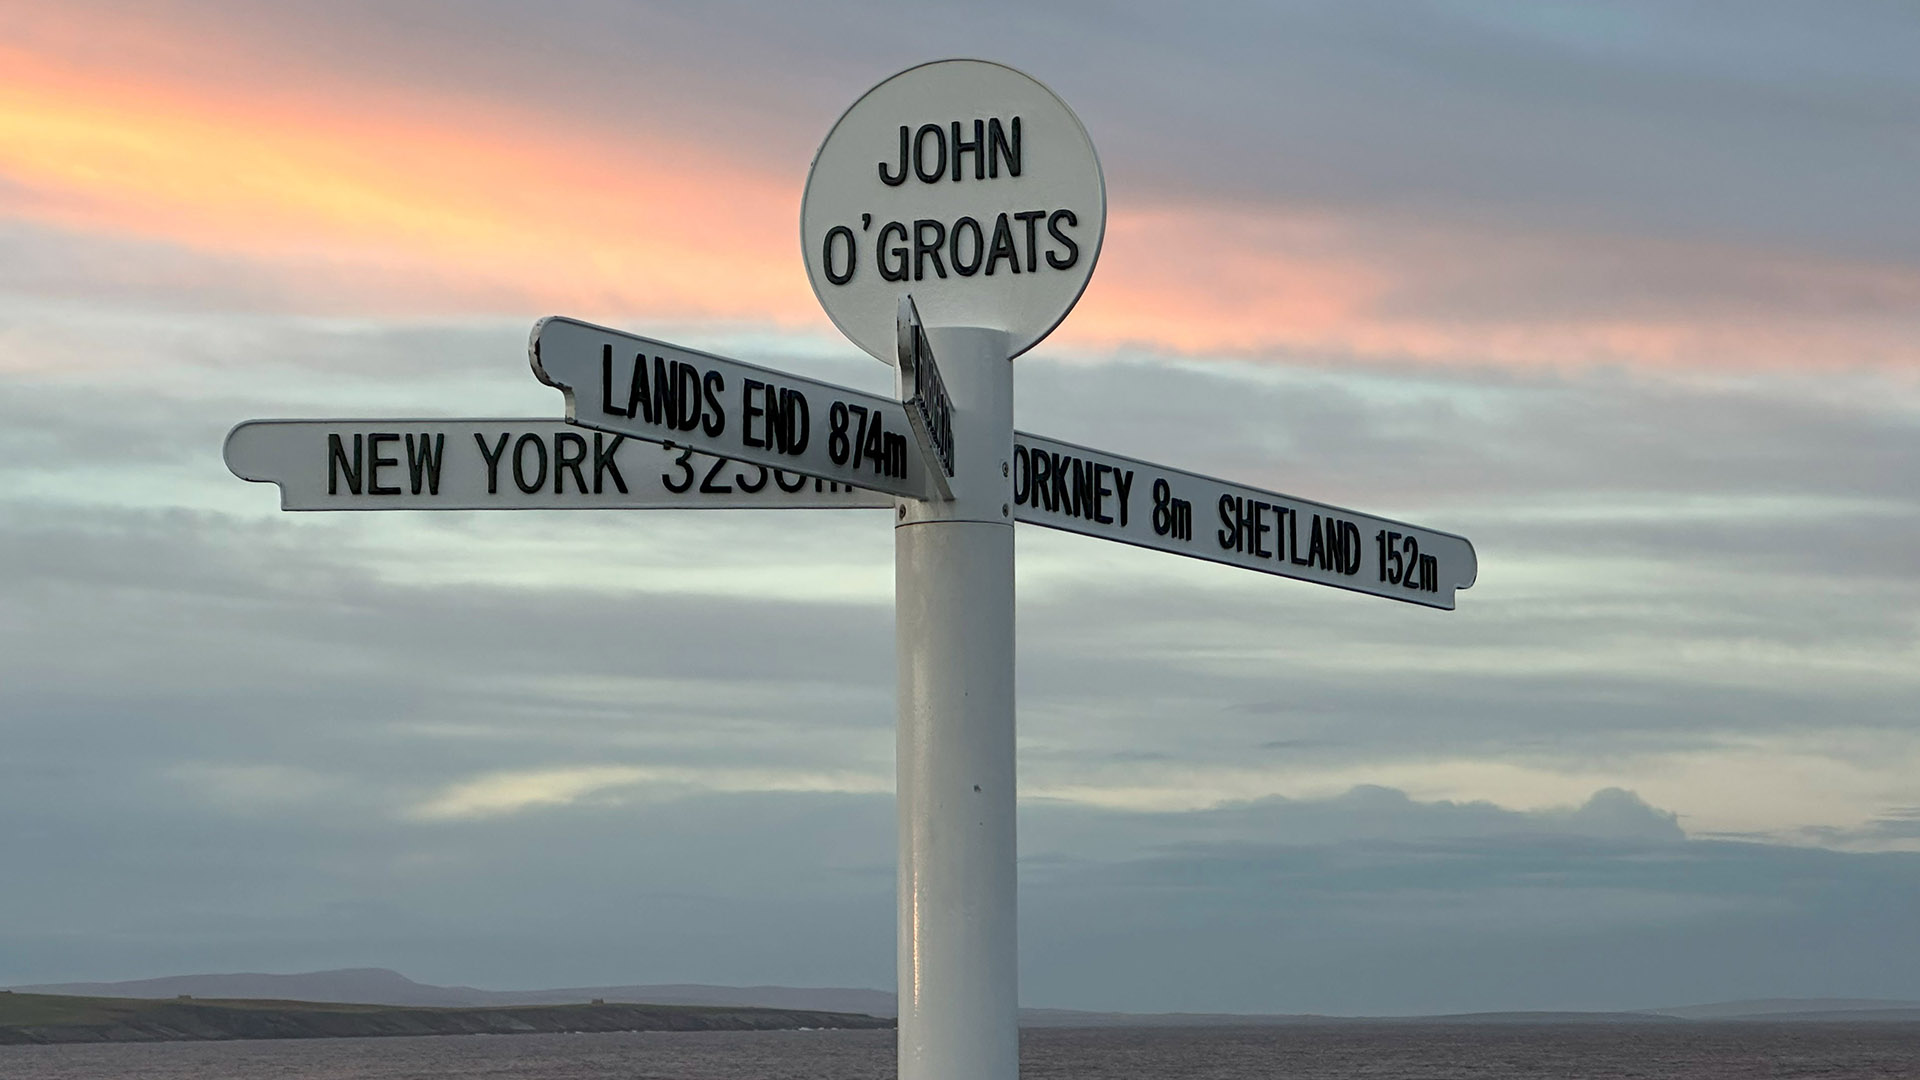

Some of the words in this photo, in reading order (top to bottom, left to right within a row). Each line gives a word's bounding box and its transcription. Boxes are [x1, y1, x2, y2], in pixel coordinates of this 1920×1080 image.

[878, 116, 1022, 187] JOHN
[822, 208, 1080, 286] O'GROATS
[602, 343, 726, 438] LANDS
[742, 377, 810, 456] END
[828, 400, 908, 480] 874m
[327, 432, 445, 496] NEW
[473, 431, 629, 495] YORK
[1013, 443, 1135, 527] ORKNEY
[1152, 478, 1193, 542] 8m
[1217, 493, 1362, 576] SHETLAND
[1375, 529, 1439, 594] 152m
